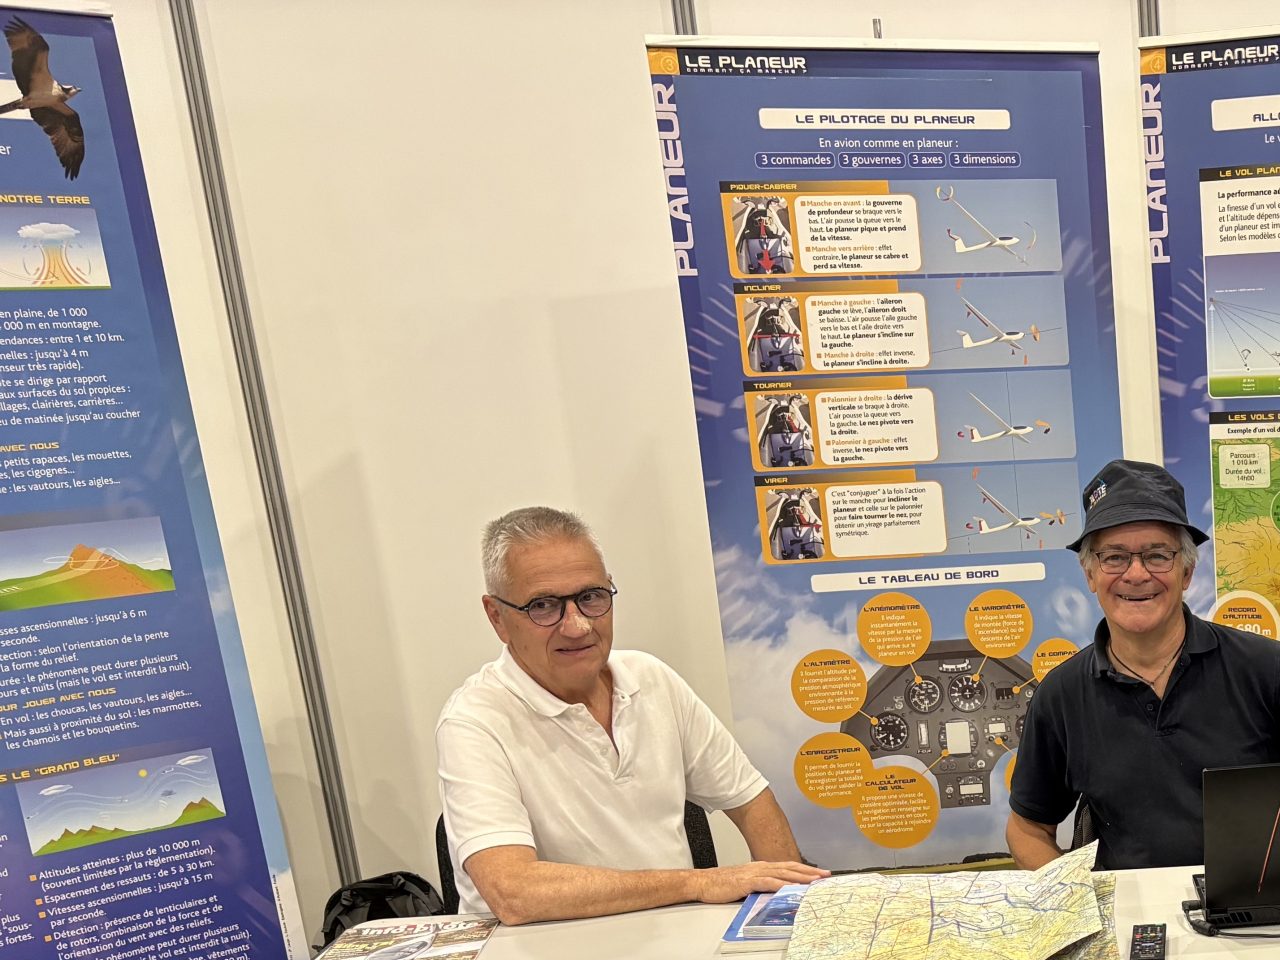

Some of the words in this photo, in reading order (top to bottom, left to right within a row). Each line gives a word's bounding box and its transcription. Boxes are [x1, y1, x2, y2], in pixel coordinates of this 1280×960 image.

[1172, 52, 1194, 65] LE
[1201, 45, 1278, 62] PLANEUR
[685, 55, 711, 67] LE
[718, 56, 805, 68] PLANEUR
[795, 115, 814, 123] LE
[819, 115, 885, 123] PILOTAGE
[891, 115, 908, 123] DU
[914, 115, 975, 124] PLANEUR
[819, 137, 831, 147] En
[834, 138, 860, 147] avion
[917, 137, 952, 150] planeur
[1264, 134, 1274, 143] Le
[761, 154, 768, 164] 3
[770, 154, 831, 164] commandes
[842, 154, 849, 164] 3
[851, 156, 901, 166] gouvernes
[912, 154, 919, 164] 3
[921, 156, 943, 164] axes
[954, 154, 960, 164] 3
[962, 154, 1016, 164] dimensions
[1142, 82, 1171, 264] PLANEUR
[1219, 169, 1231, 177] LE
[653, 82, 698, 277] PLANEUR
[48, 194, 90, 205] TERRE
[1226, 190, 1271, 199] performance
[858, 576, 876, 584] LE
[881, 573, 939, 583] TABLEAU
[944, 572, 961, 580] DE
[966, 570, 999, 578] BORD
[0, 717, 13, 725] En
[14, 713, 30, 723] vol
[35, 711, 49, 720] les
[50, 705, 87, 717] choucas,
[88, 702, 102, 710] les
[103, 697, 145, 707] vautours,
[146, 693, 159, 701] les
[12, 771, 31, 780] LE
